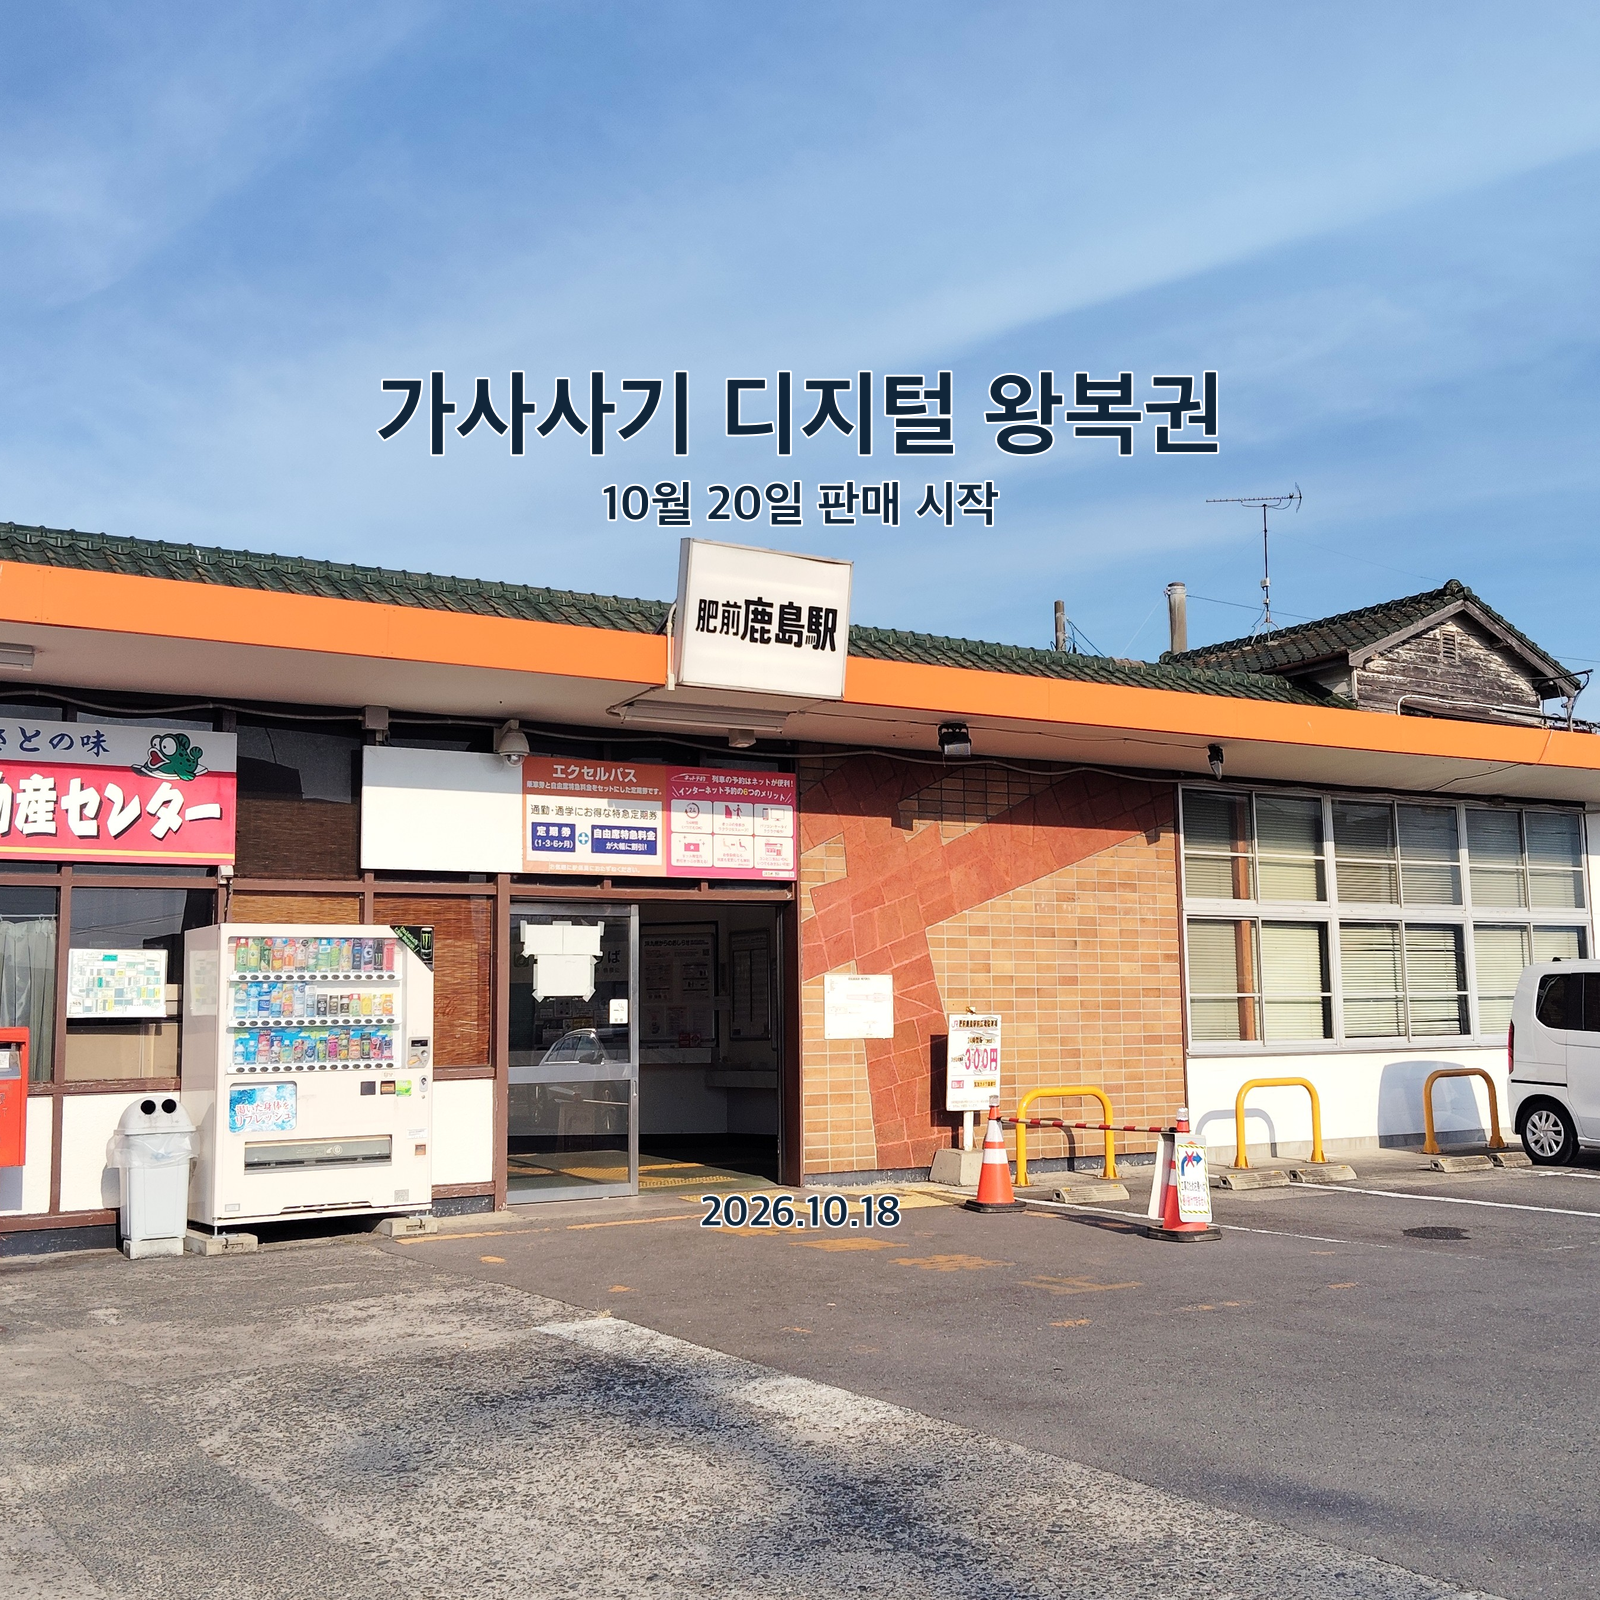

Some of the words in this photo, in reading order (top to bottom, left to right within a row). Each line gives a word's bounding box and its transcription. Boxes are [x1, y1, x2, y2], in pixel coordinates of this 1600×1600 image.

[695, 596, 838, 652] 肥前鹿島駅
[552, 764, 637, 783] エクセルパス
[536, 826, 571, 837] 定期券
[593, 829, 656, 840] 自由席特急料金
[236, 1113, 292, 1126] リフレッシュ
